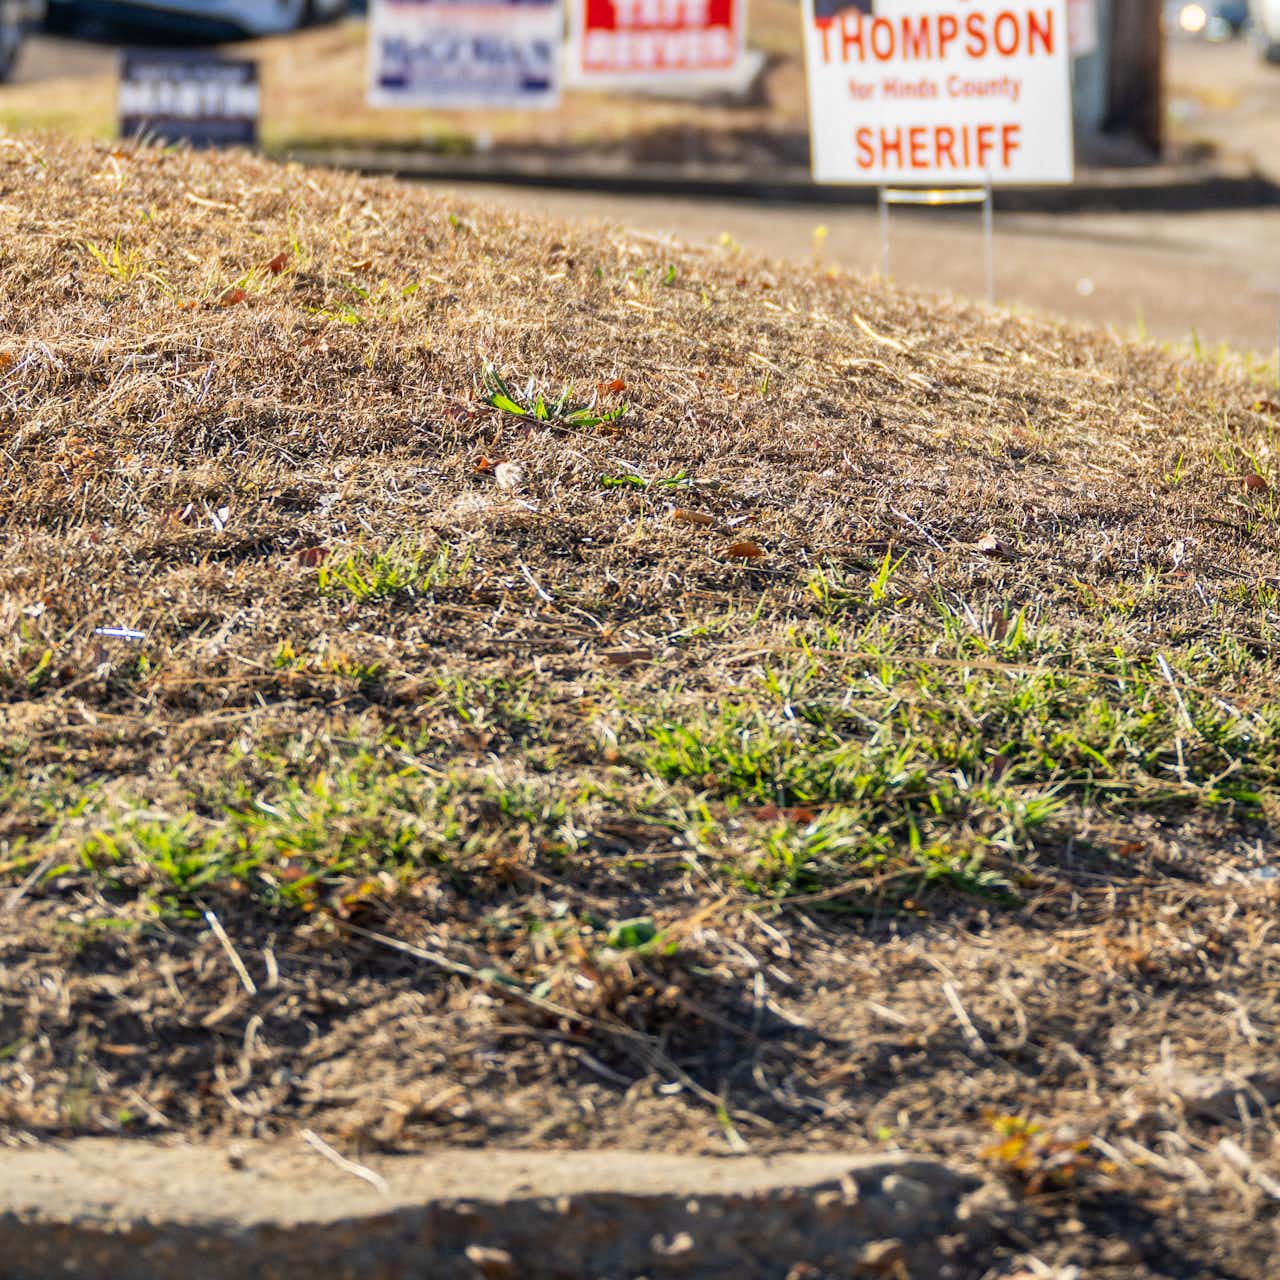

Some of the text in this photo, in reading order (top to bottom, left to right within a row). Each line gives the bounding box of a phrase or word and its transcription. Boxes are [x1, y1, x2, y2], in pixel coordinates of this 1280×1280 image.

[813, 8, 1056, 63] THOMPSON
[848, 73, 1021, 103] for Hinds County
[855, 123, 1022, 171] SHERIFF
